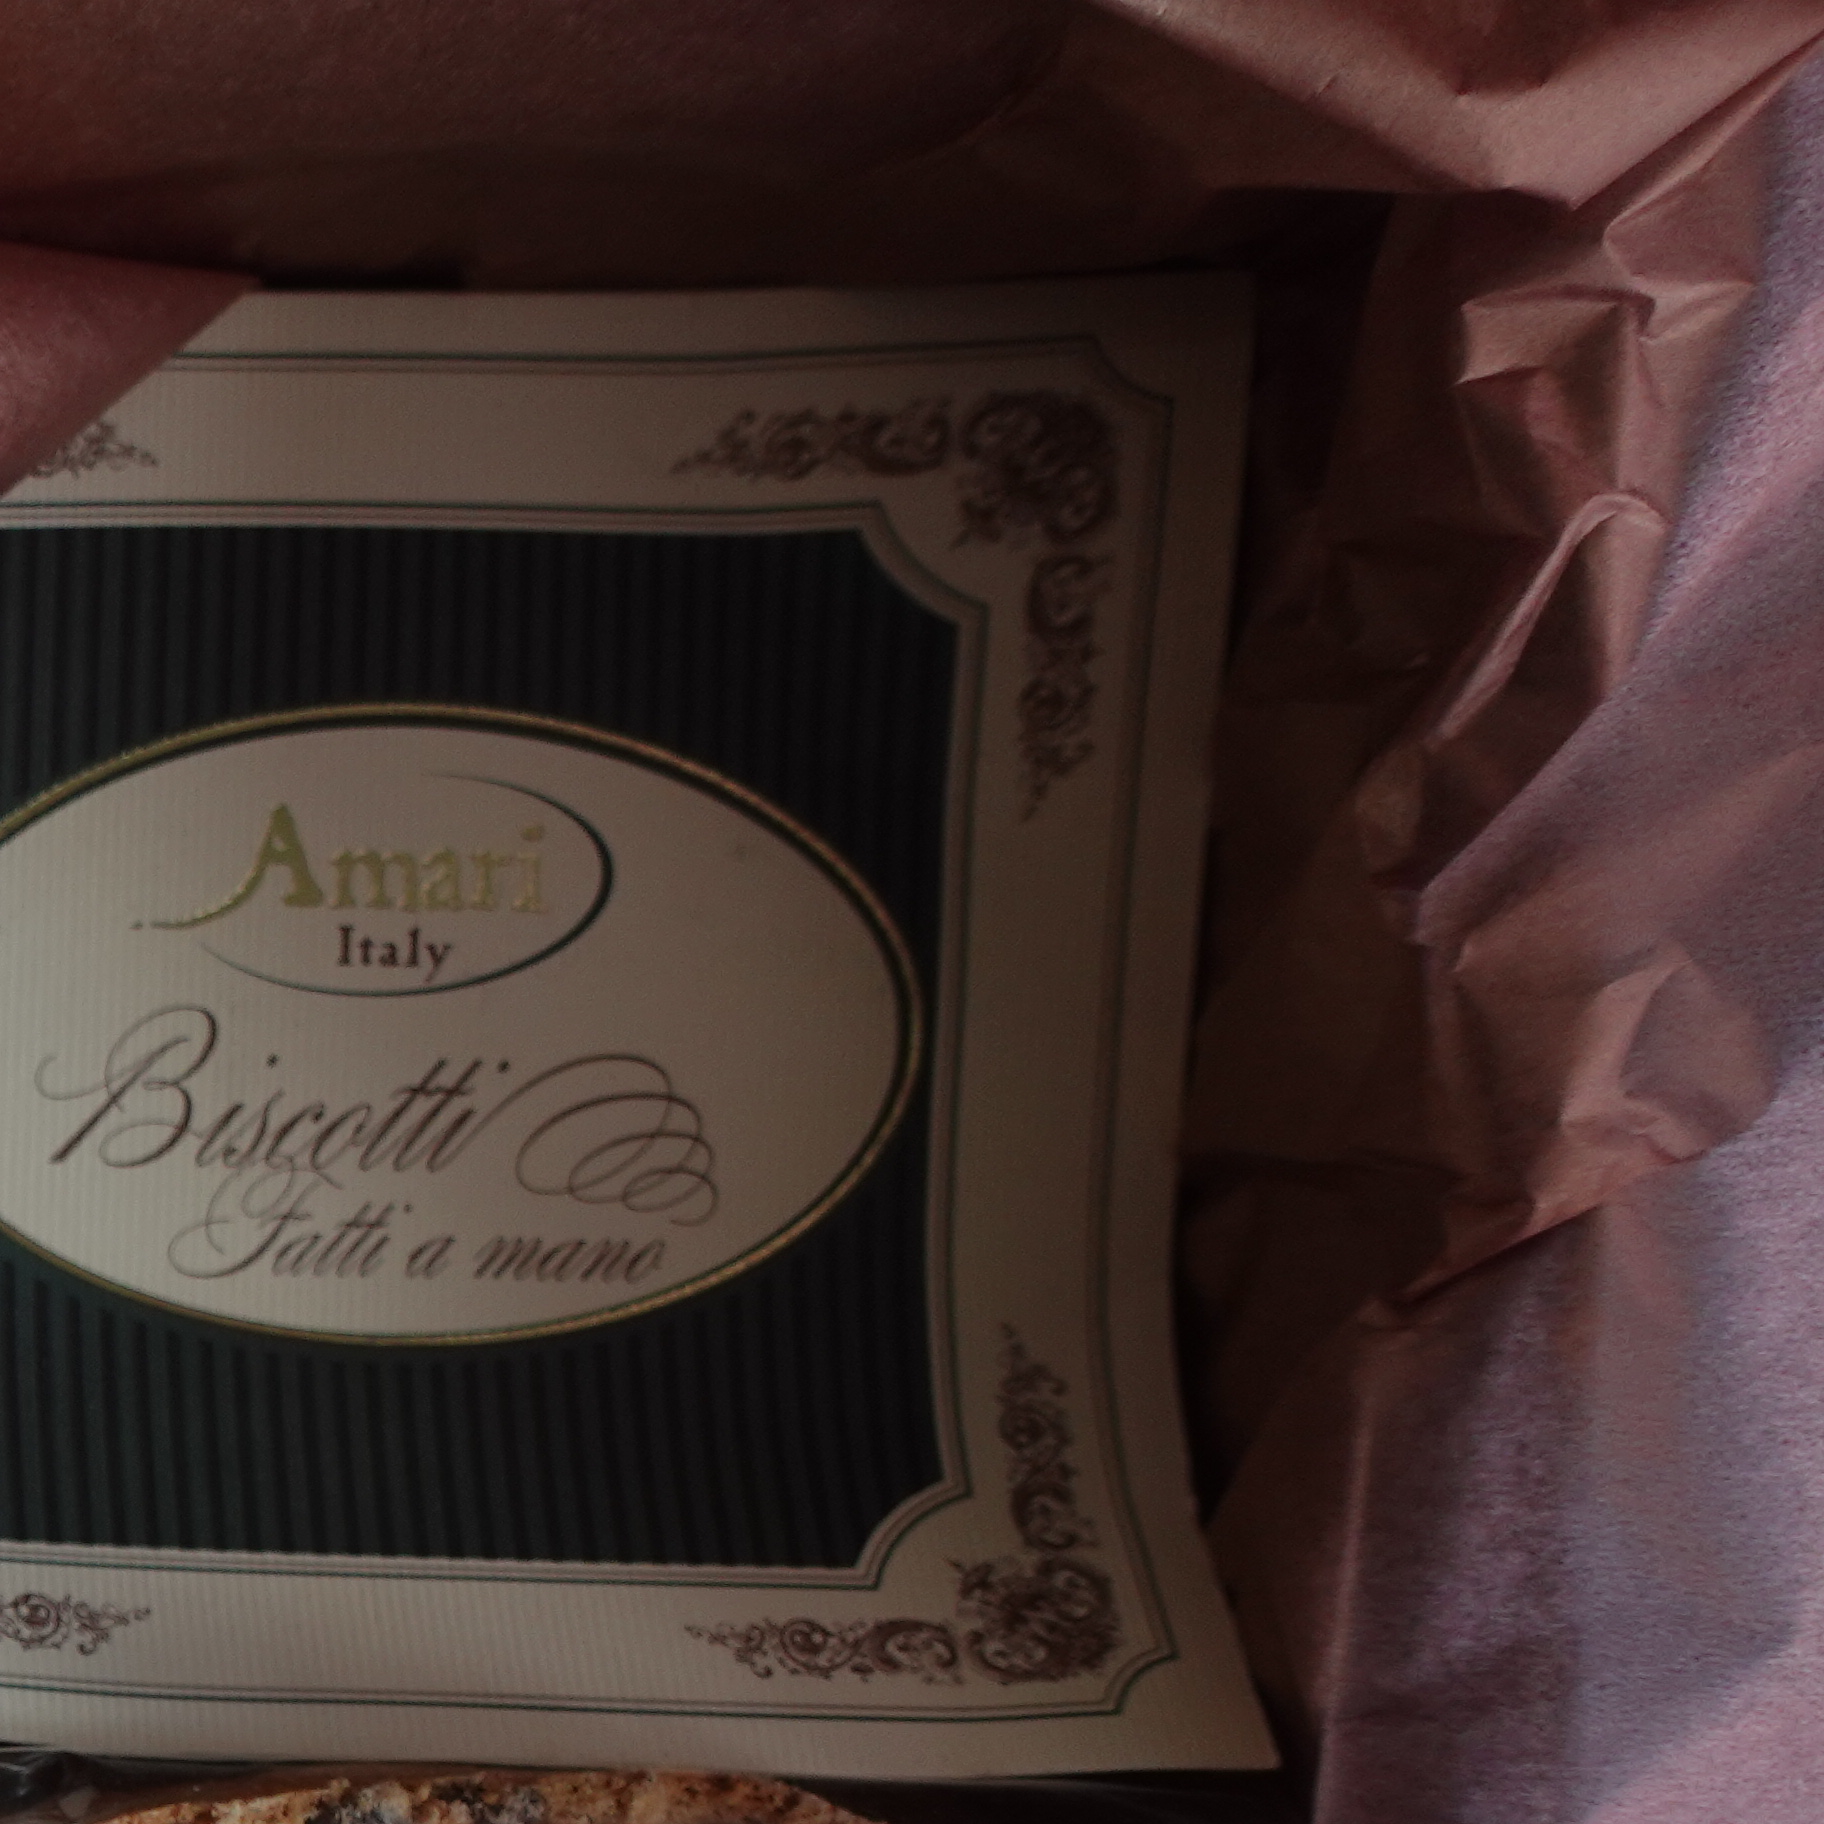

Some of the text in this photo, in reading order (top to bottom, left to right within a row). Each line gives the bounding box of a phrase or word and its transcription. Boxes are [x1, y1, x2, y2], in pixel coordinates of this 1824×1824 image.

[142, 803, 548, 930] Amari
[336, 923, 454, 984] Italy
[36, 1005, 652, 1200] Biscotti
[404, 1234, 453, 1282] a
[471, 1232, 666, 1287] mano
